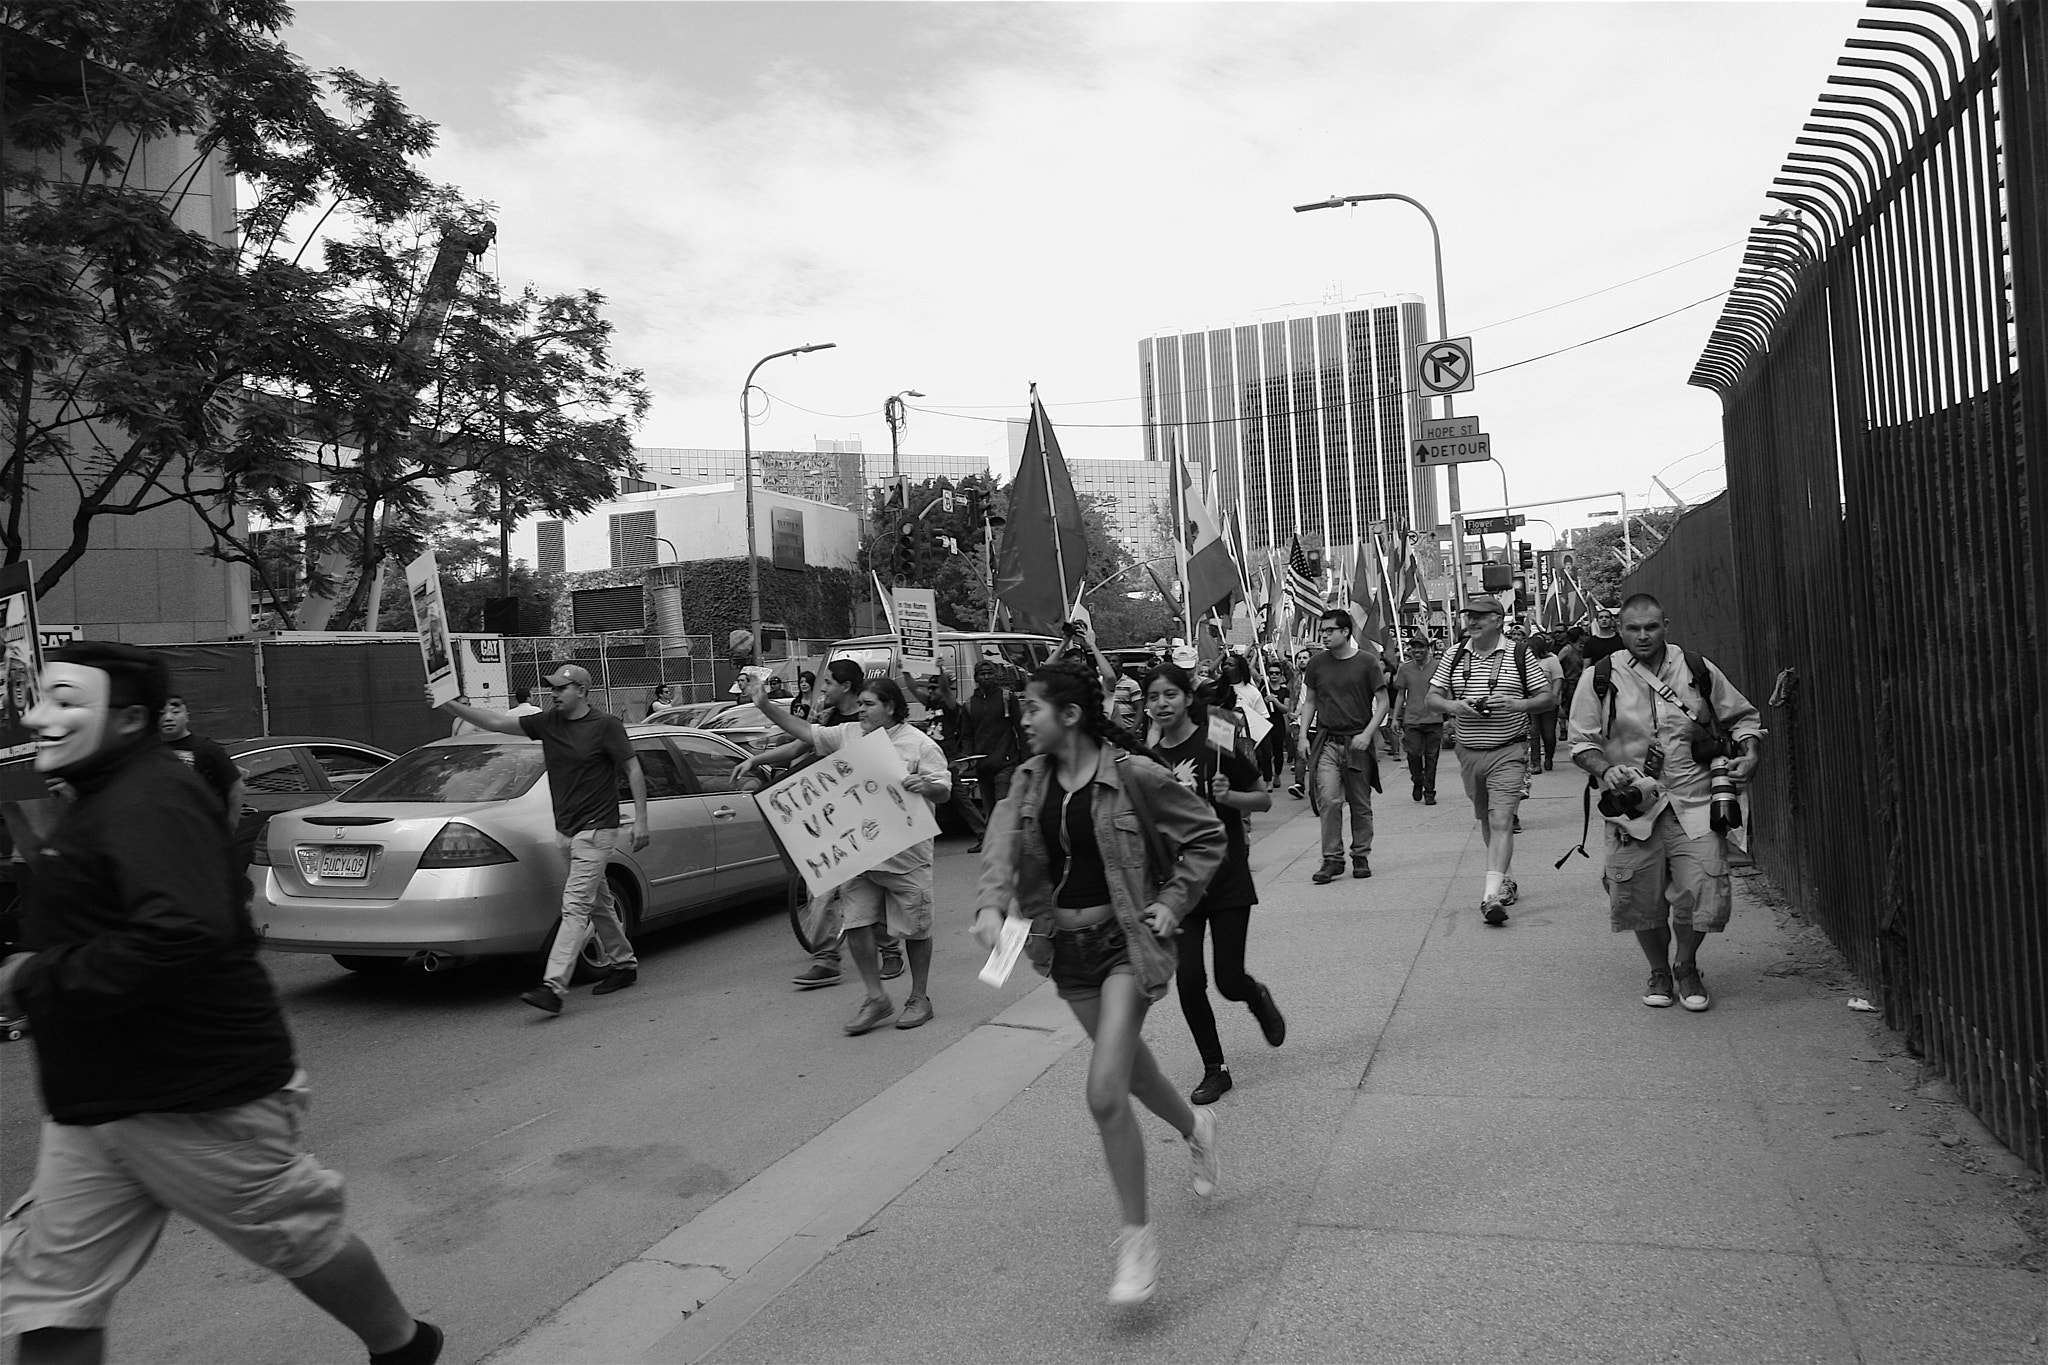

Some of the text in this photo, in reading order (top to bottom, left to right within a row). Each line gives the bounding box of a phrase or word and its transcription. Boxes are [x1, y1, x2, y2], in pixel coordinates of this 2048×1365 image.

[1427, 425, 1473, 438] HOPE ST
[1430, 441, 1488, 458] DETOUR
[1467, 519, 1494, 529] Flower
[1503, 516, 1514, 526] St
[480, 640, 498, 656] CAT
[867, 668, 886, 679] lift?
[769, 759, 853, 824] STAND
[802, 779, 879, 839] UP TO
[806, 818, 881, 879] HATE
[323, 857, 364, 872] 5UCY409
